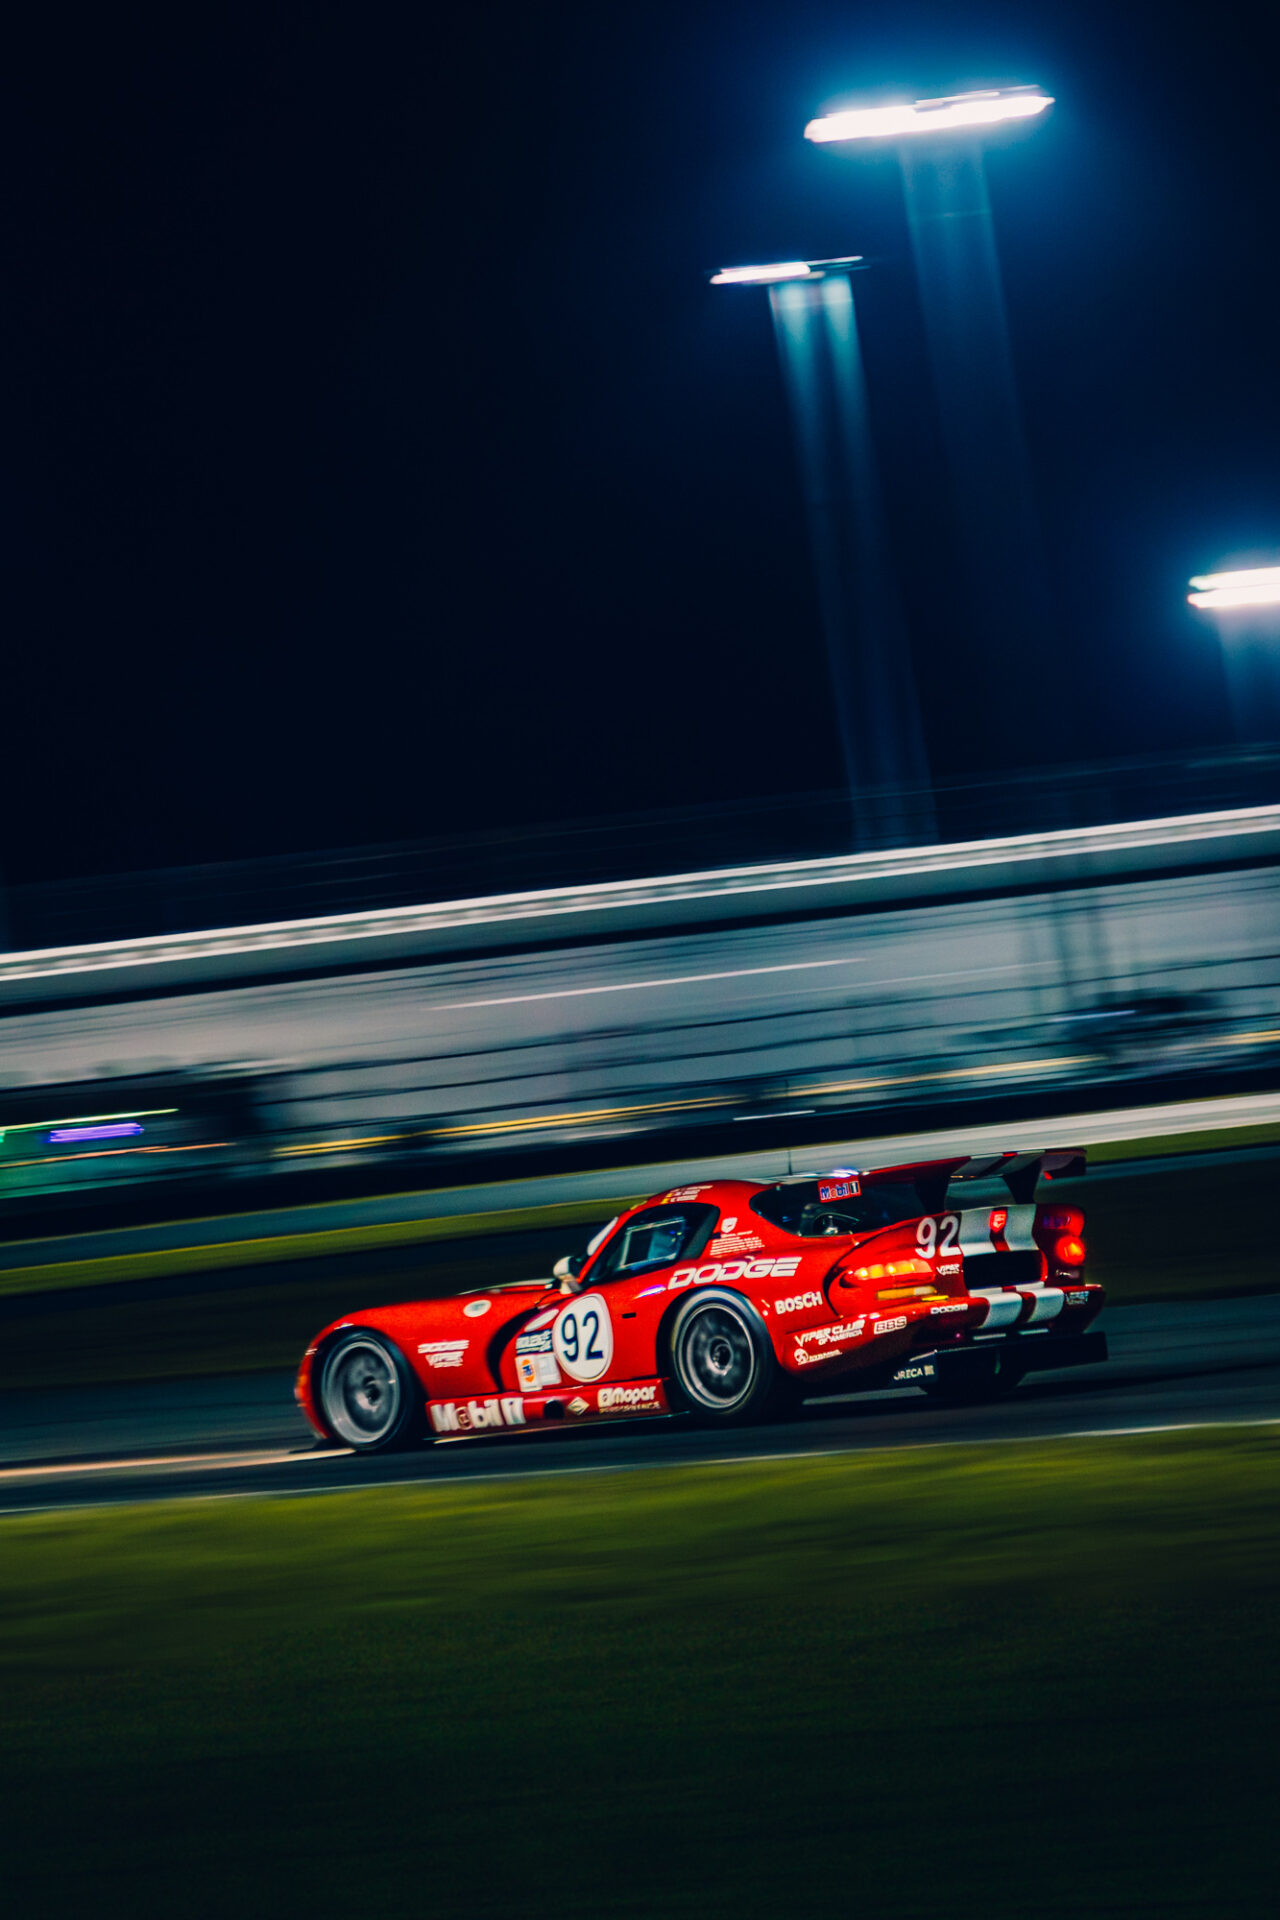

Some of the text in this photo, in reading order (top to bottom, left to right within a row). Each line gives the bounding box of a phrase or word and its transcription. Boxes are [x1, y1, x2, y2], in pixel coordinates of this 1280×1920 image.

[820, 1182, 849, 1200] Mobil
[915, 1215, 962, 1259] 92
[667, 1256, 803, 1290] DODGE
[774, 1291, 823, 1315] BOSCH
[875, 1316, 907, 1334] BBS
[561, 1311, 604, 1363] 92
[794, 1327, 832, 1347] VIPER
[818, 1336, 829, 1346] OF
[612, 1385, 656, 1405] Mopar
[430, 1398, 504, 1432] Mobil
